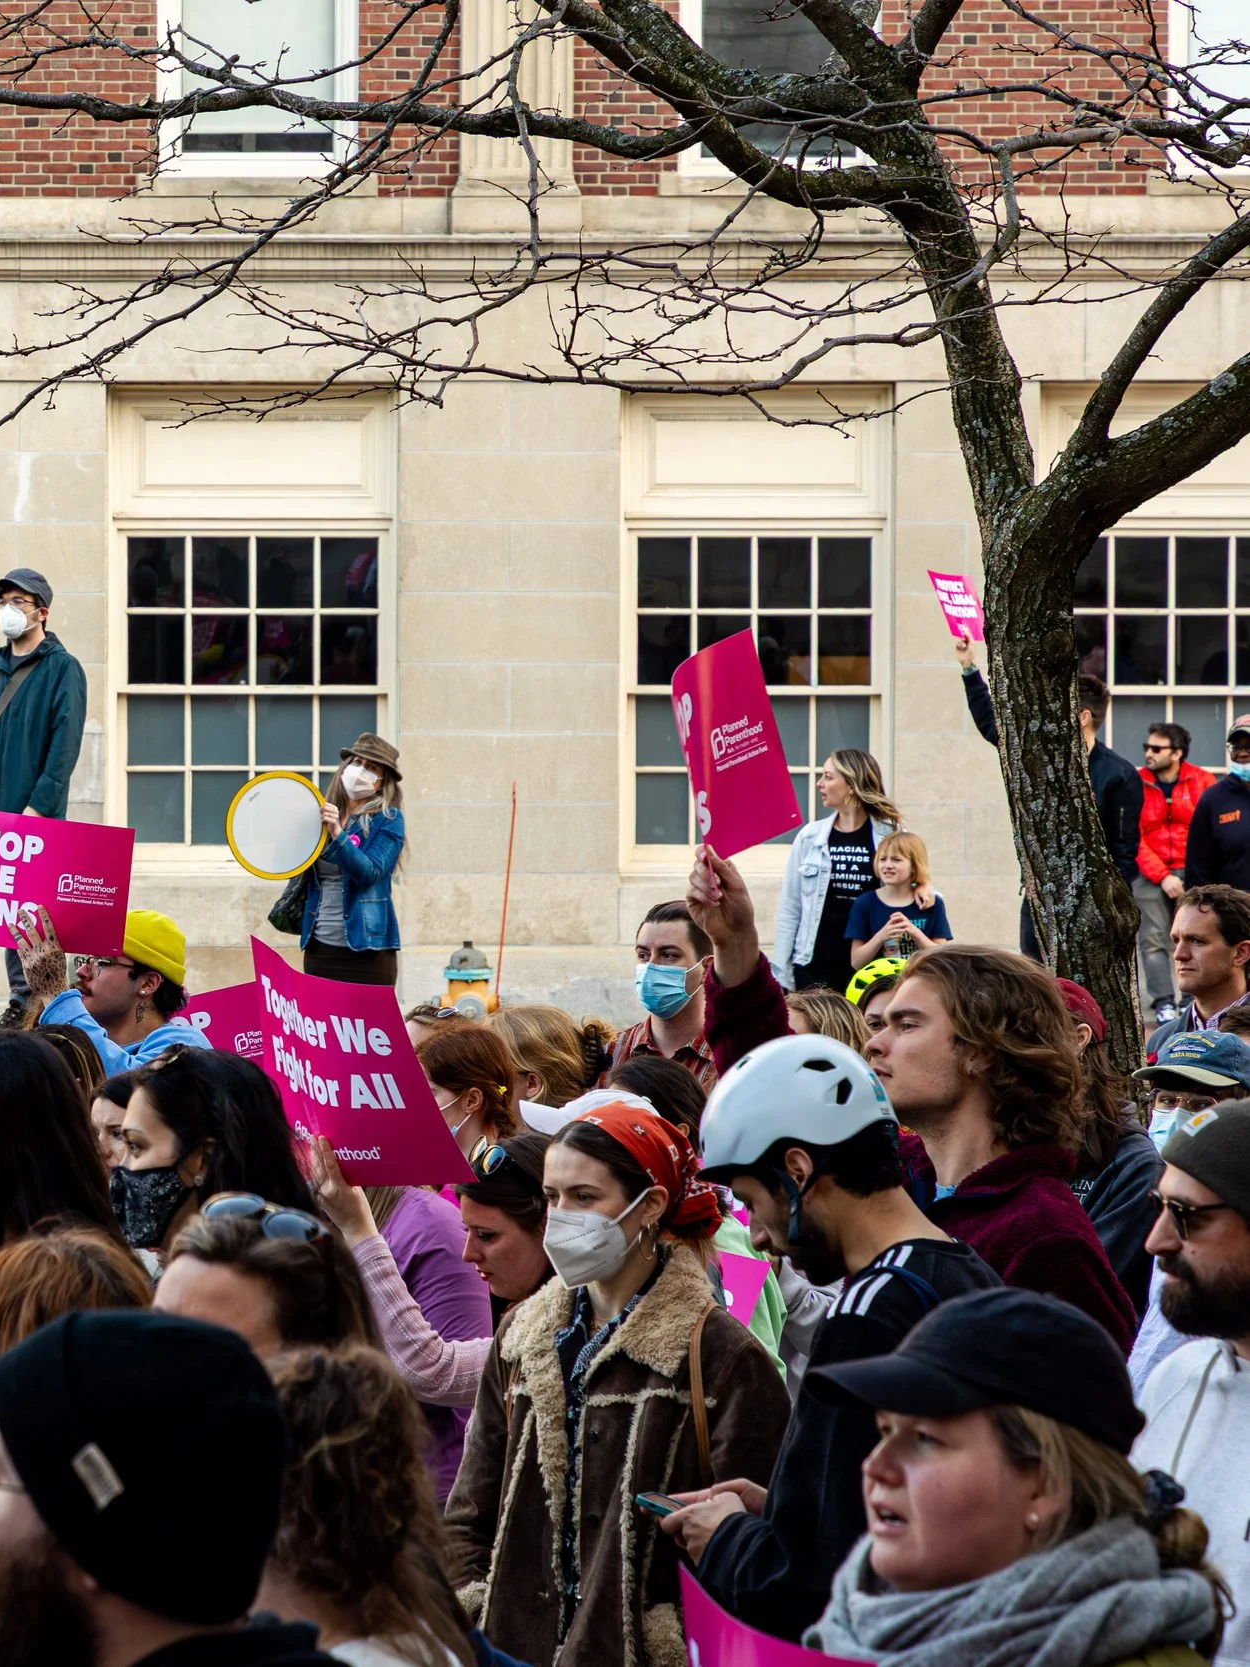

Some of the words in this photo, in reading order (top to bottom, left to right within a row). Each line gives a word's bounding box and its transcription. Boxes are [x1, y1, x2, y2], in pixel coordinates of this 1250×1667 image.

[721, 715, 748, 735] Planned
[724, 721, 763, 746] Parenthood
[830, 846, 869, 854] RACIAL
[836, 863, 847, 871] IS
[74, 874, 104, 885] Planned
[830, 873, 873, 882] EMINIST
[73, 882, 116, 894] Parenthood
[832, 882, 863, 891] ISSUE.
[260, 974, 328, 1050] Together
[329, 1014, 393, 1057] We
[246, 1030, 263, 1038] Plan
[272, 1035, 308, 1095] Fight
[305, 1059, 340, 1108] for
[350, 1073, 407, 1110] All
